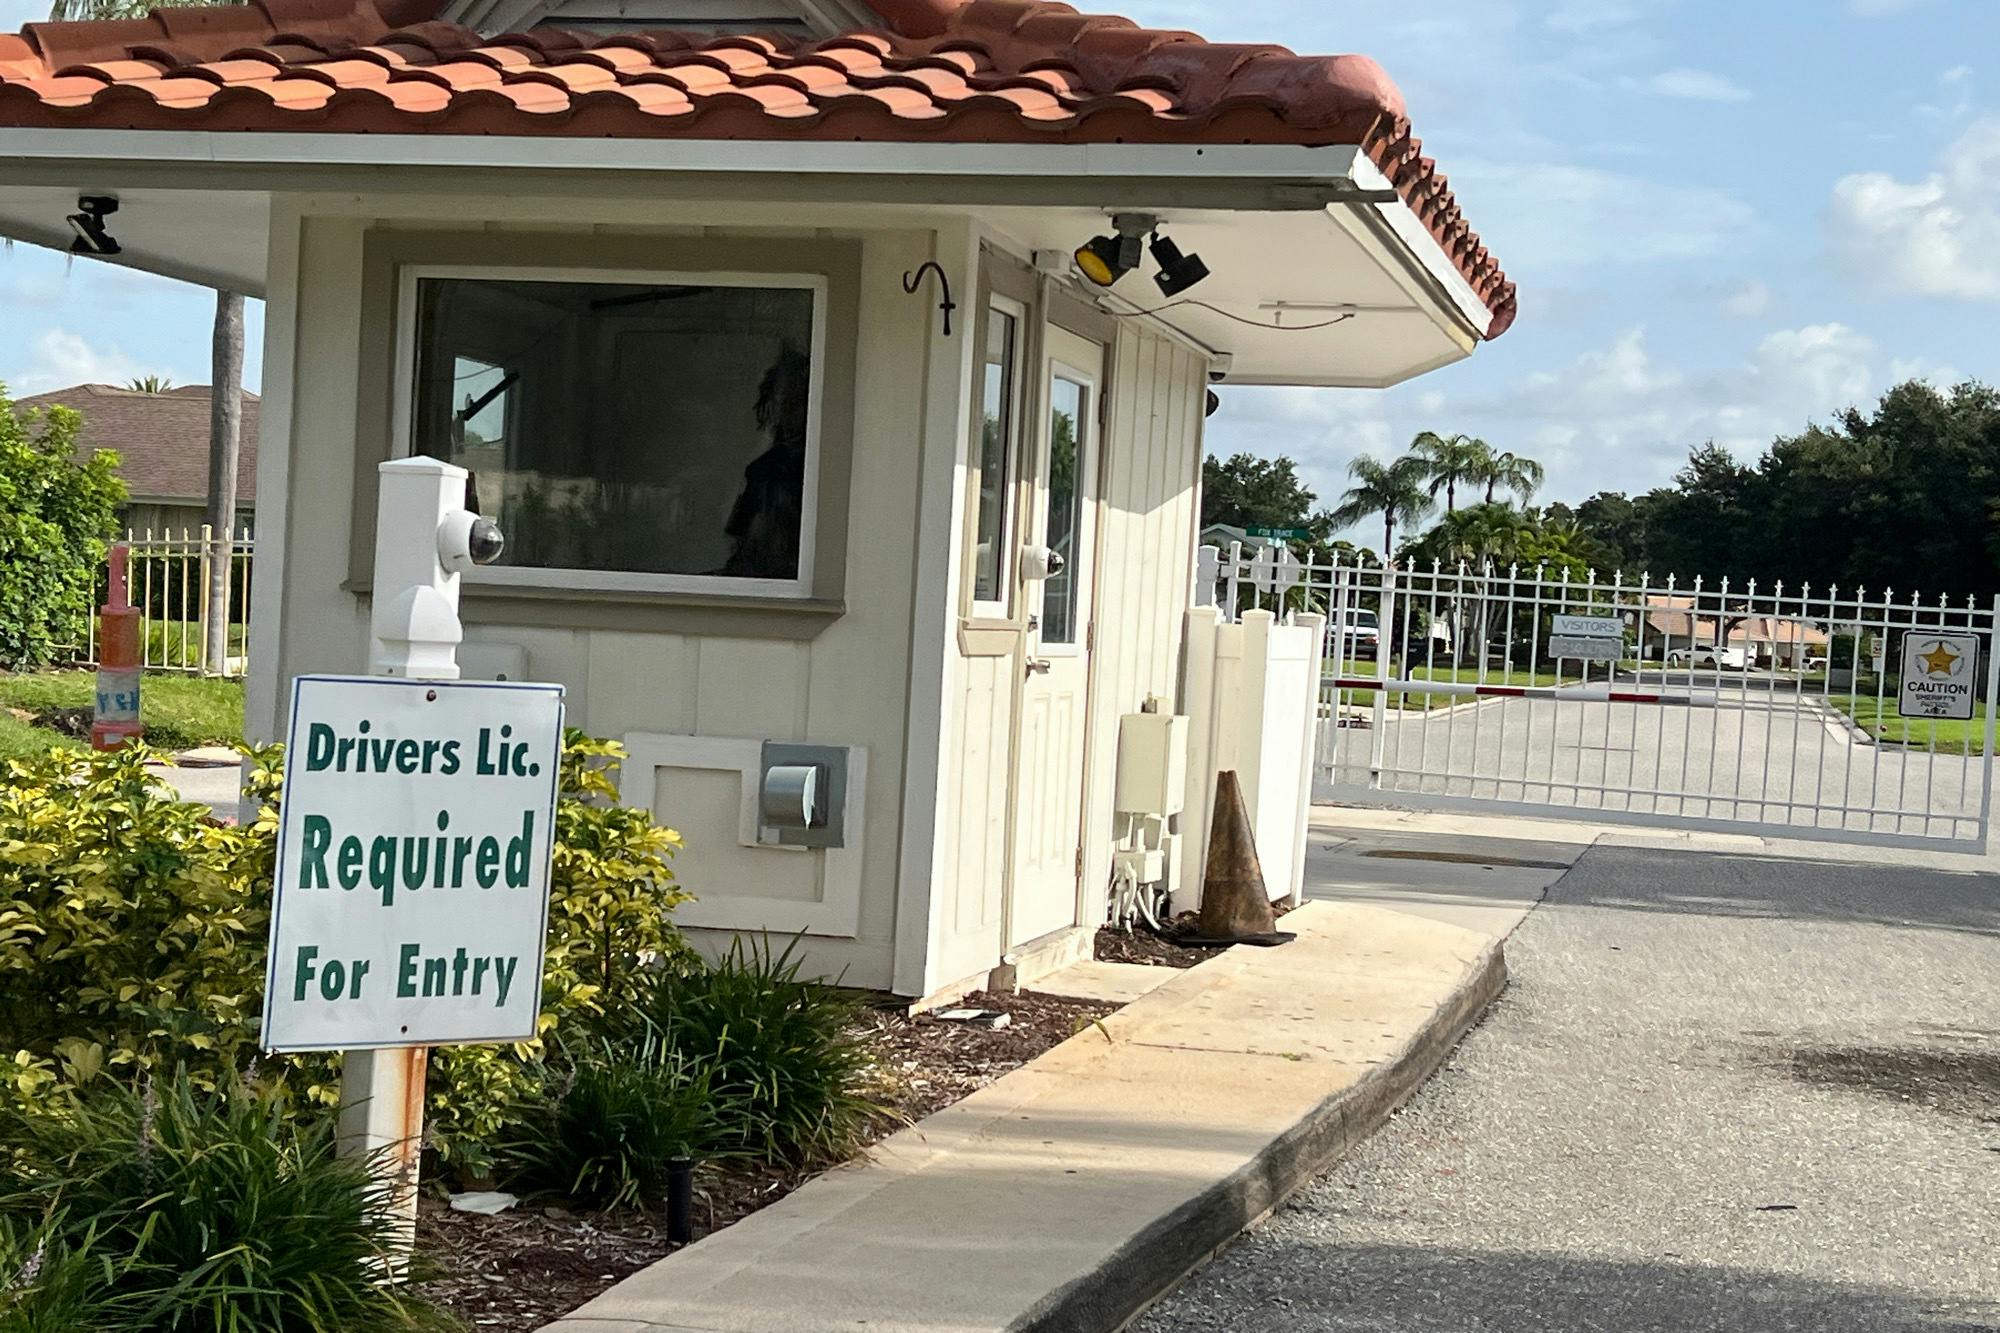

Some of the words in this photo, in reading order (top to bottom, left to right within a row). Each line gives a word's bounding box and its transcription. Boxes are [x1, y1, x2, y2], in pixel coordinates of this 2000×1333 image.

[1561, 620, 1616, 633] VISITORS
[1908, 681, 1968, 694] CAUTION
[305, 719, 461, 775] Drivers
[476, 724, 541, 777] Lic.
[298, 809, 535, 907] Required
[293, 945, 370, 1002] For
[396, 943, 519, 1008] Entry
